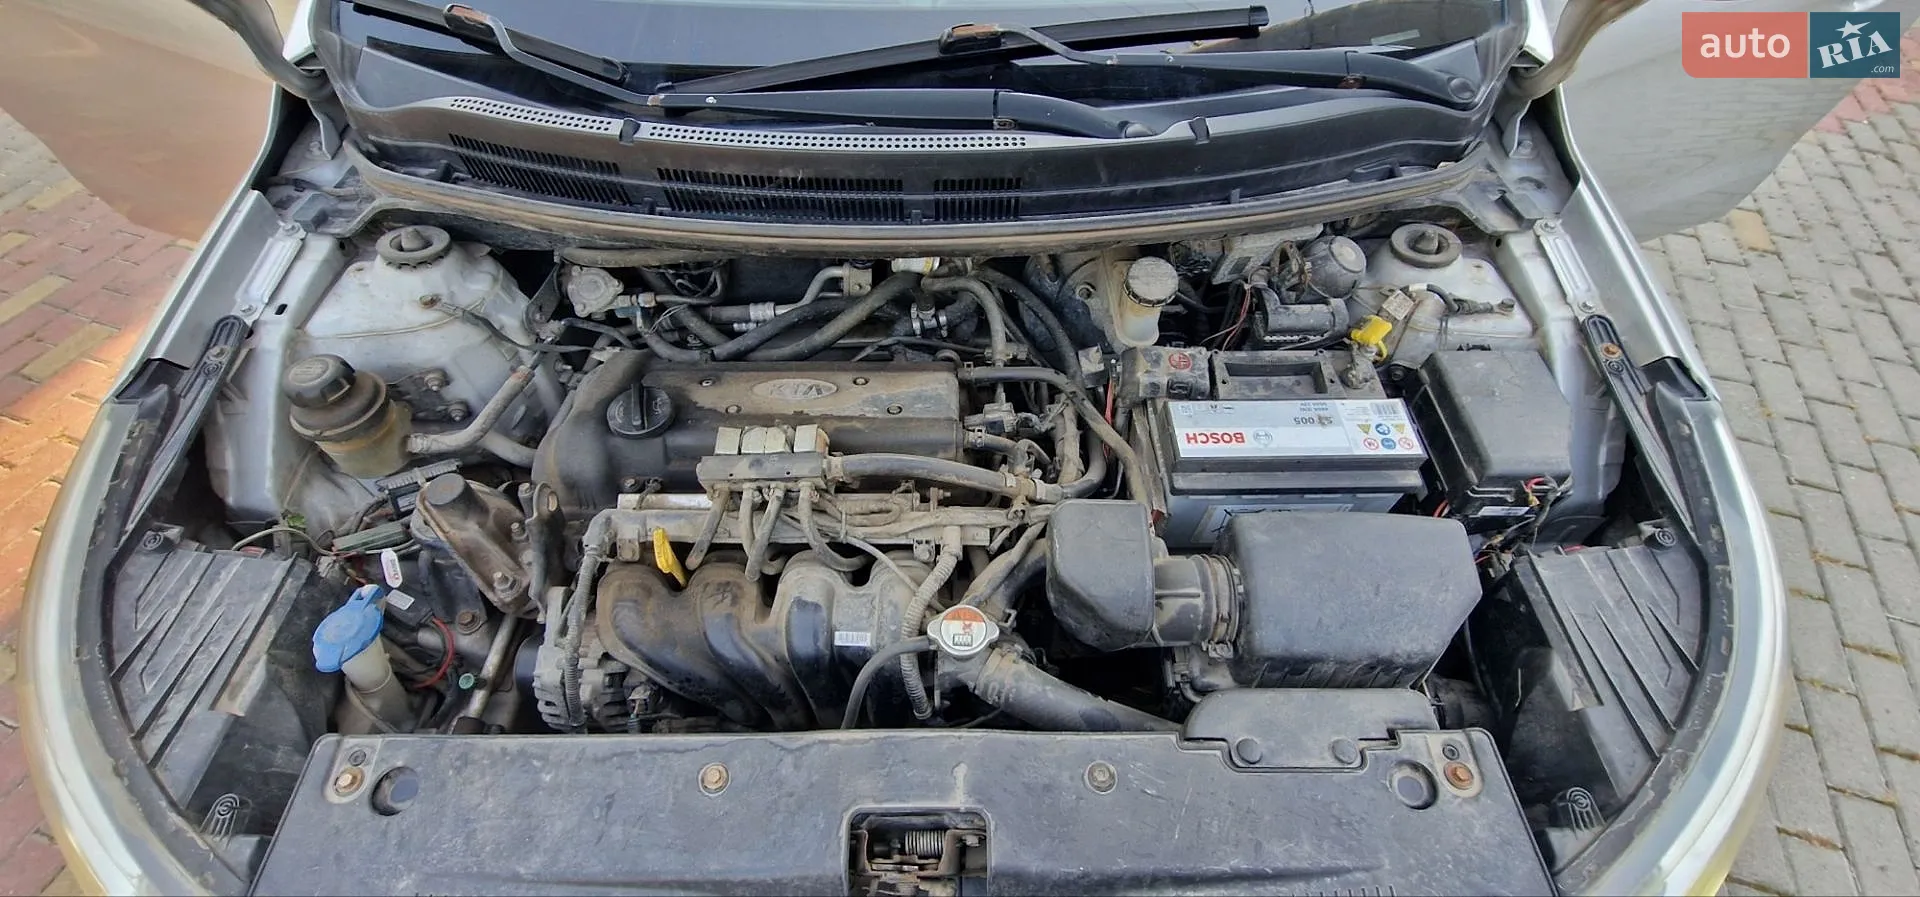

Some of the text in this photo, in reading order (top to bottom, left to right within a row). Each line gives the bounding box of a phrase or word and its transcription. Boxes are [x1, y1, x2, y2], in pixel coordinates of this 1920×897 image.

[769, 383, 824, 396] KIA
[1293, 416, 1316, 425] 005
[1185, 431, 1245, 445] BOSCH
